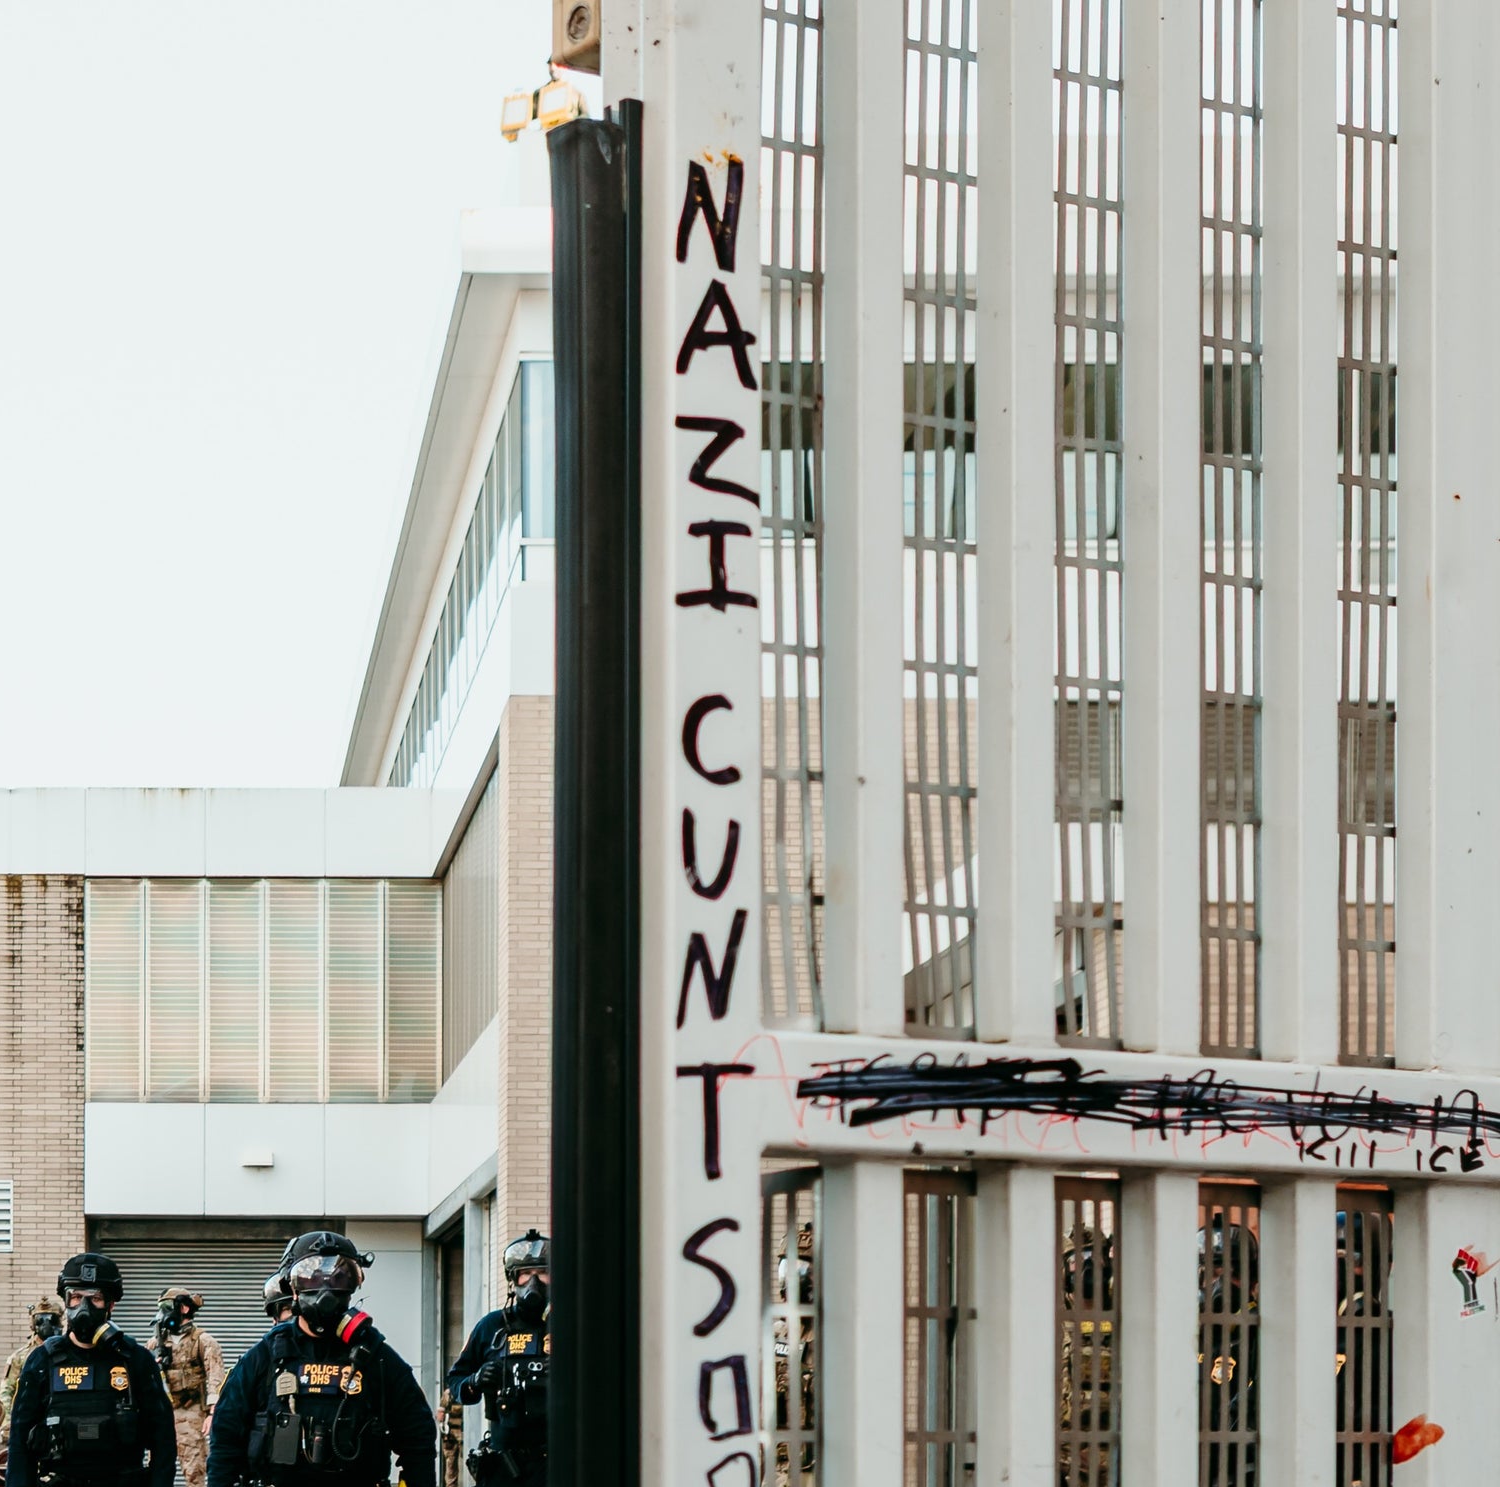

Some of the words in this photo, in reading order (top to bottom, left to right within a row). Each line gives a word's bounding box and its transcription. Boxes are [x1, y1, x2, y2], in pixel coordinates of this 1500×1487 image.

[675, 153, 761, 613] NAZI
[509, 1341, 526, 1350] DHS
[59, 1366, 89, 1377] POLICE
[303, 1364, 340, 1376] POLICE
[64, 1375, 83, 1385] DHS
[310, 1374, 331, 1385] DHS
